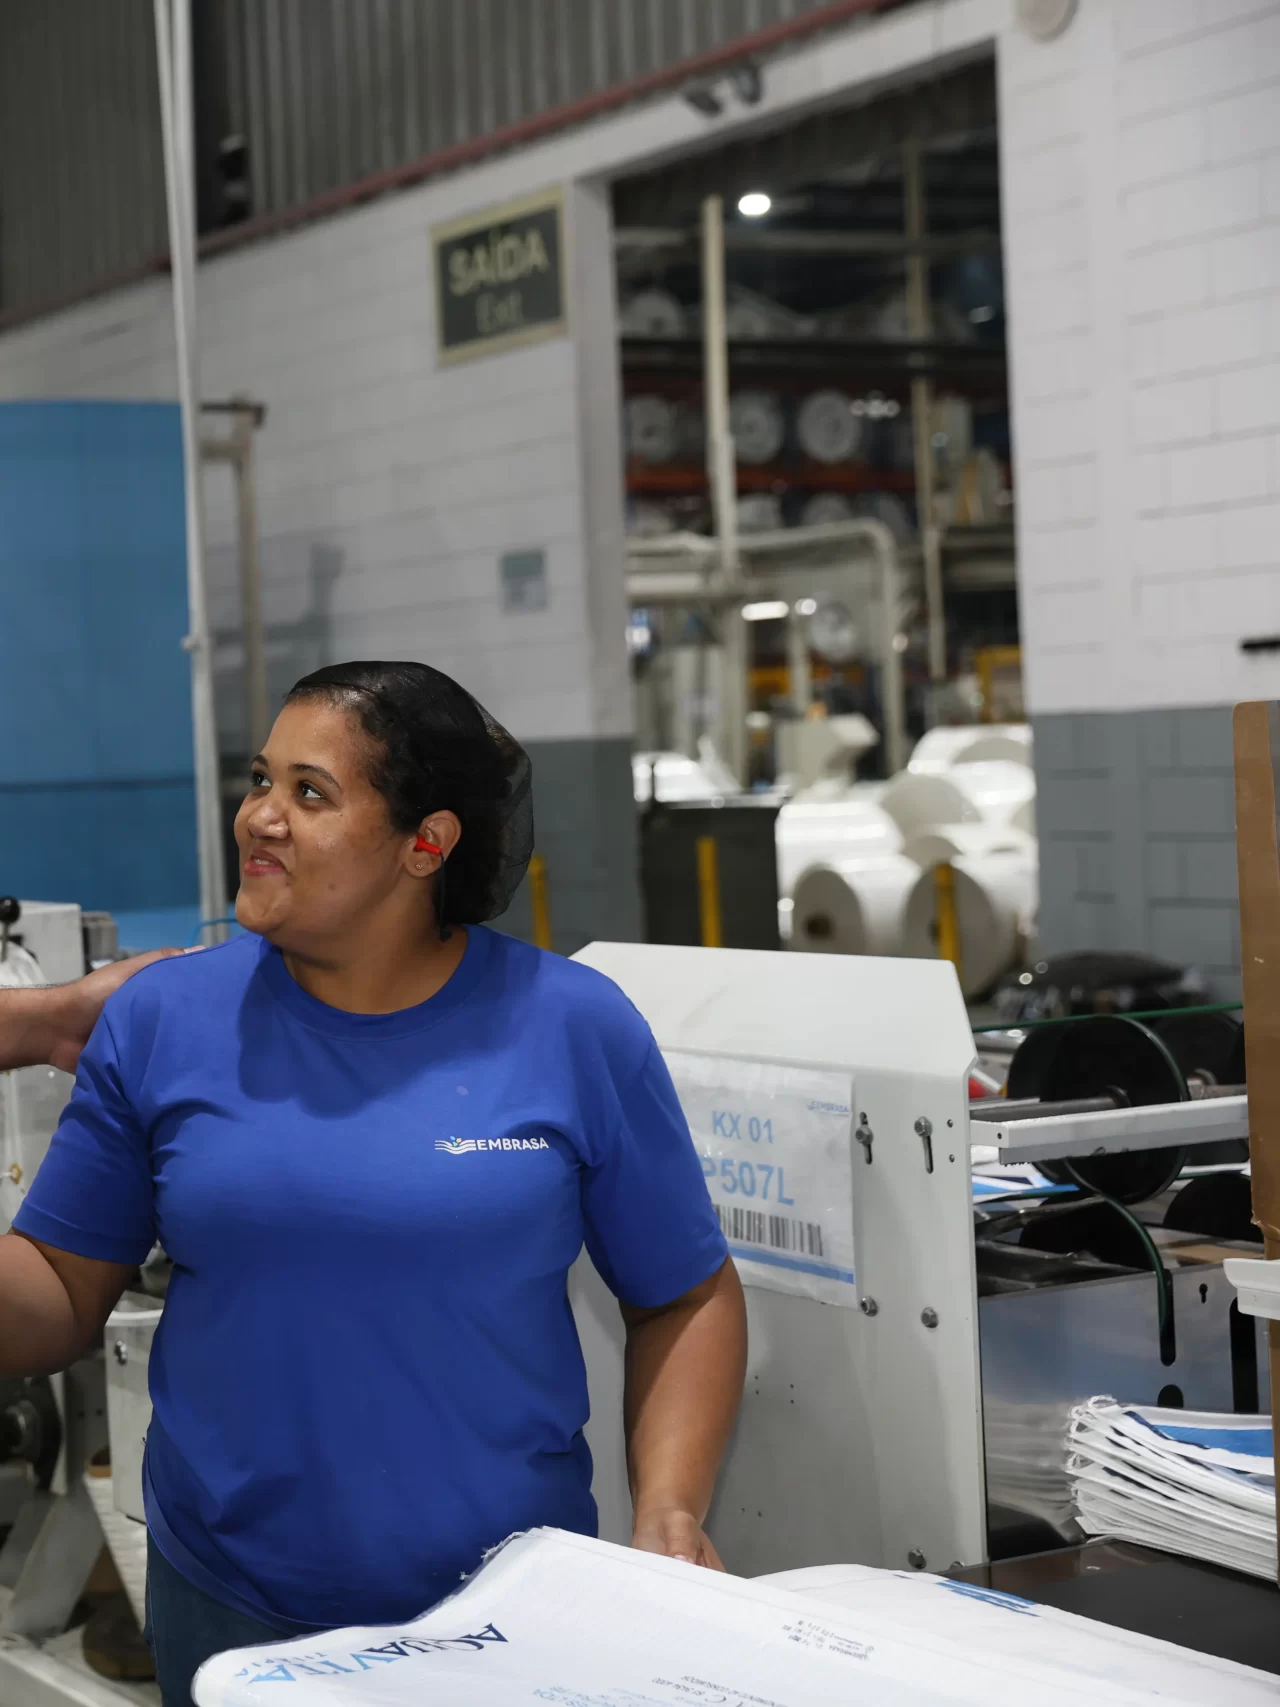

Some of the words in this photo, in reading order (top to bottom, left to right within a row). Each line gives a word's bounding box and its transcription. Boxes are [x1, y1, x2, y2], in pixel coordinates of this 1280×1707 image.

[448, 226, 549, 297] SAÍDA
[476, 1137, 549, 1151] EMBRASA
[712, 1110, 742, 1139] KX
[748, 1116, 774, 1144] 01
[247, 1622, 509, 1684] AQUAVITA
